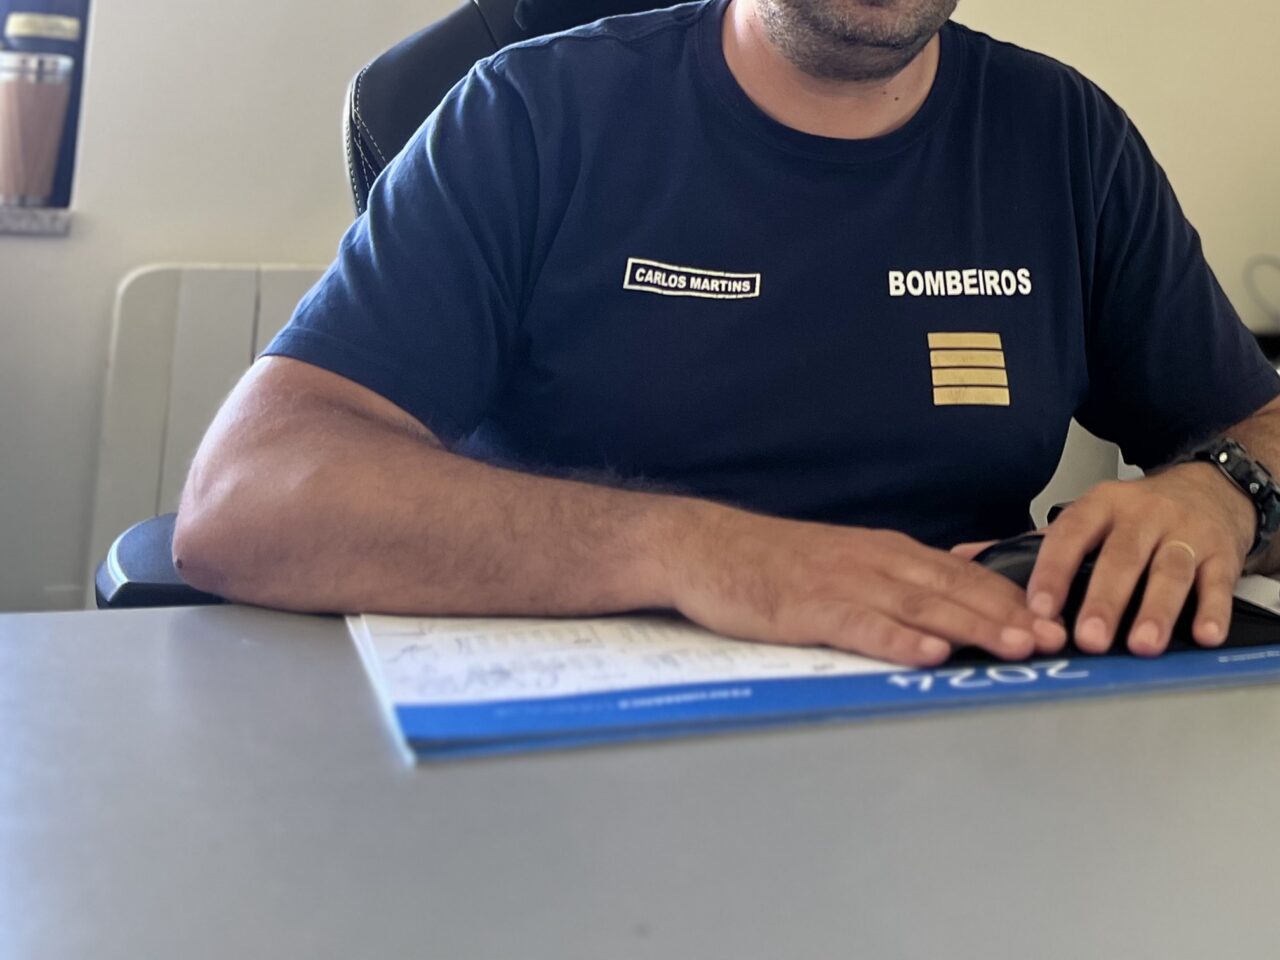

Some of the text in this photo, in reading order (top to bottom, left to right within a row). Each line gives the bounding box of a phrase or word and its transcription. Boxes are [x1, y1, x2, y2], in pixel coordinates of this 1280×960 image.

[635, 268, 751, 292] CARLOS MARTINS
[888, 268, 1032, 296] BOMBEIROS
[887, 660, 1089, 692] 2024
